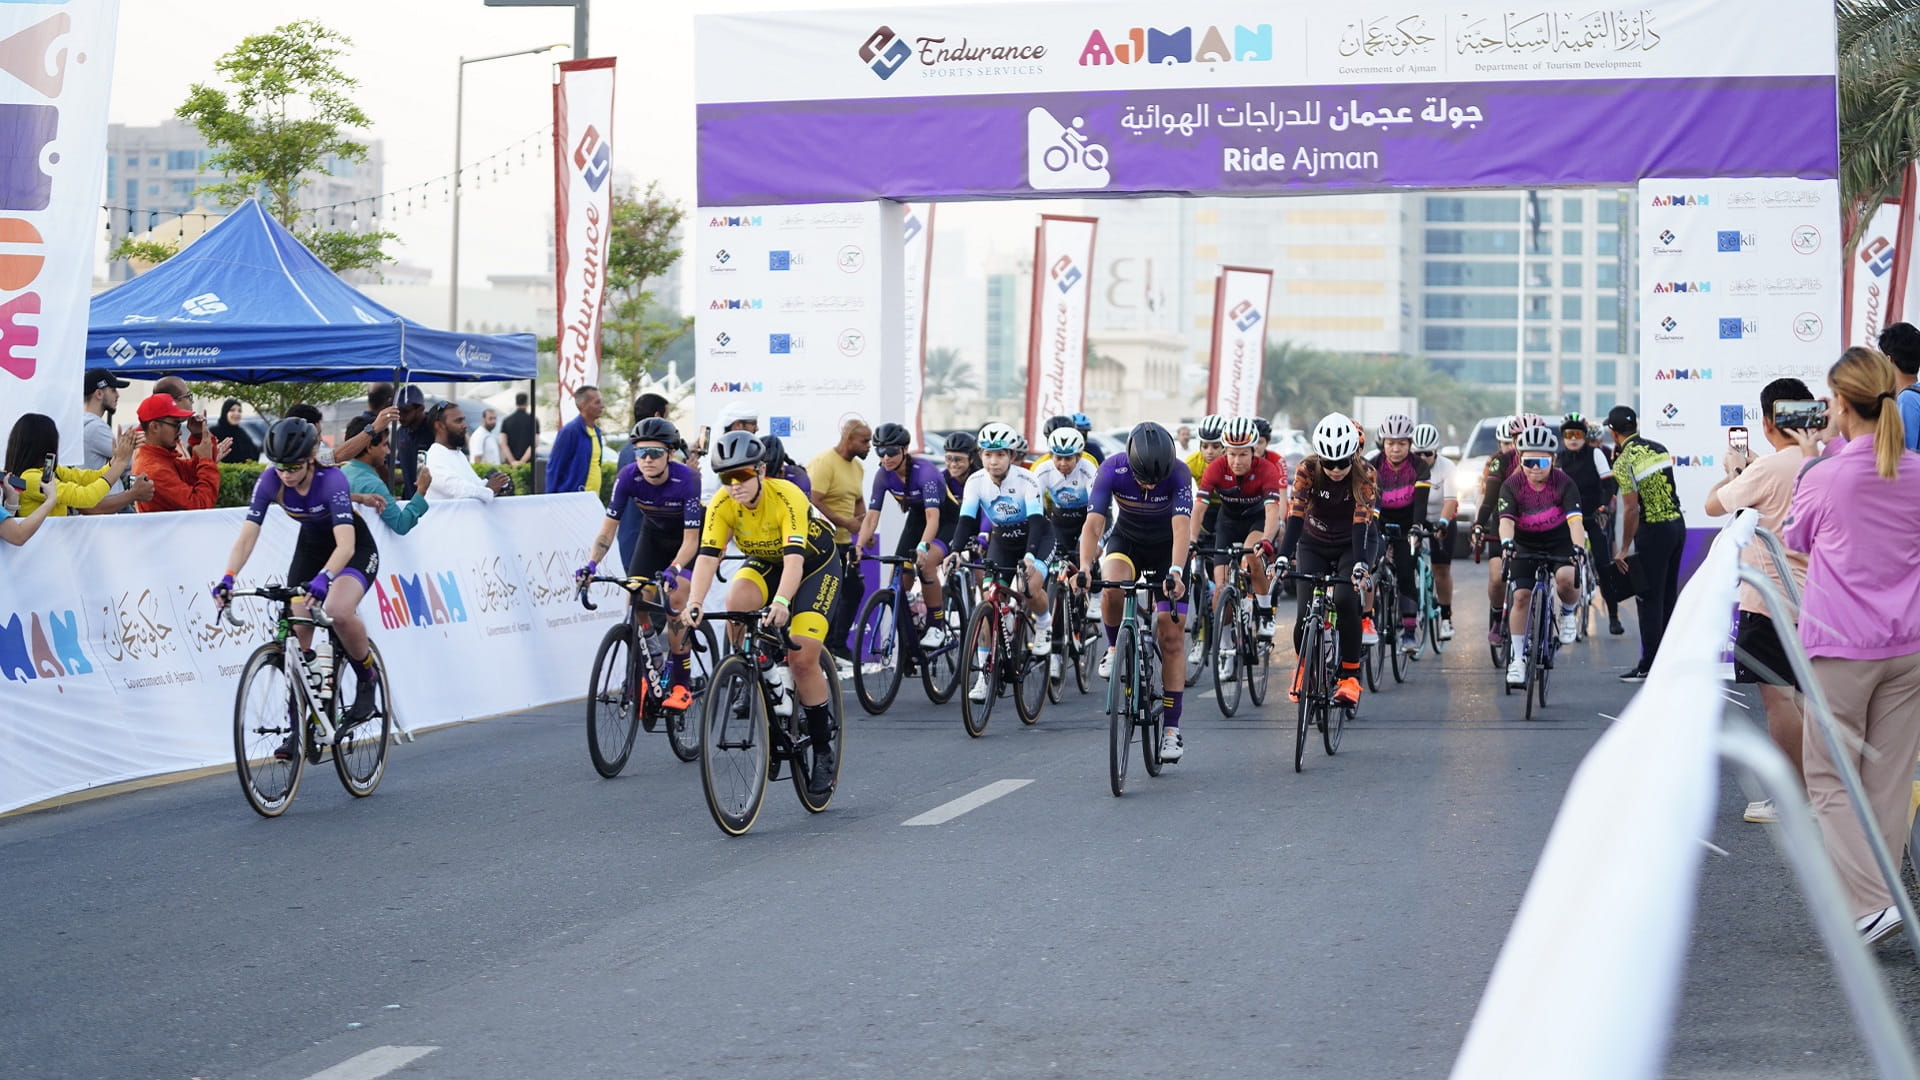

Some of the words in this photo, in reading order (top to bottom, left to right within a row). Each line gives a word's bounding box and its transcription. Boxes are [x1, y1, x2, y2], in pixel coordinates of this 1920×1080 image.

[916, 37, 1048, 66] Endurance
[1079, 24, 1273, 71] AJMAN
[922, 68, 974, 79] SPORTS
[977, 65, 1044, 76] SERVICES
[1338, 66, 1393, 75] Government
[1396, 64, 1406, 73] of
[1408, 64, 1438, 75] Ajman
[1475, 62, 1529, 73] Department
[1532, 62, 1542, 71] of
[1546, 61, 1581, 70] Tourism
[1584, 60, 1643, 71] Development
[1121, 103, 1209, 137] الهوائية
[1217, 100, 1321, 133] للدراجات
[1329, 99, 1413, 132] عجمان
[1420, 97, 1483, 129] جولة
[1223, 146, 1286, 172] Ride
[1292, 146, 1379, 177] Ajman
[1651, 195, 1710, 207] AJMAN
[709, 215, 763, 227] AJMAN
[1654, 281, 1711, 293] AJMAN
[563, 200, 600, 401] Endurance
[709, 298, 763, 310] AJMAN
[1865, 281, 1881, 349] rance
[140, 340, 221, 358] Endurance
[1655, 368, 1712, 380] AJMAN
[710, 381, 763, 393] AJMAN
[374, 570, 468, 632] AJMAN
[123, 674, 166, 690] Government
[166, 671, 175, 685] of
[174, 670, 196, 687] Ajman
